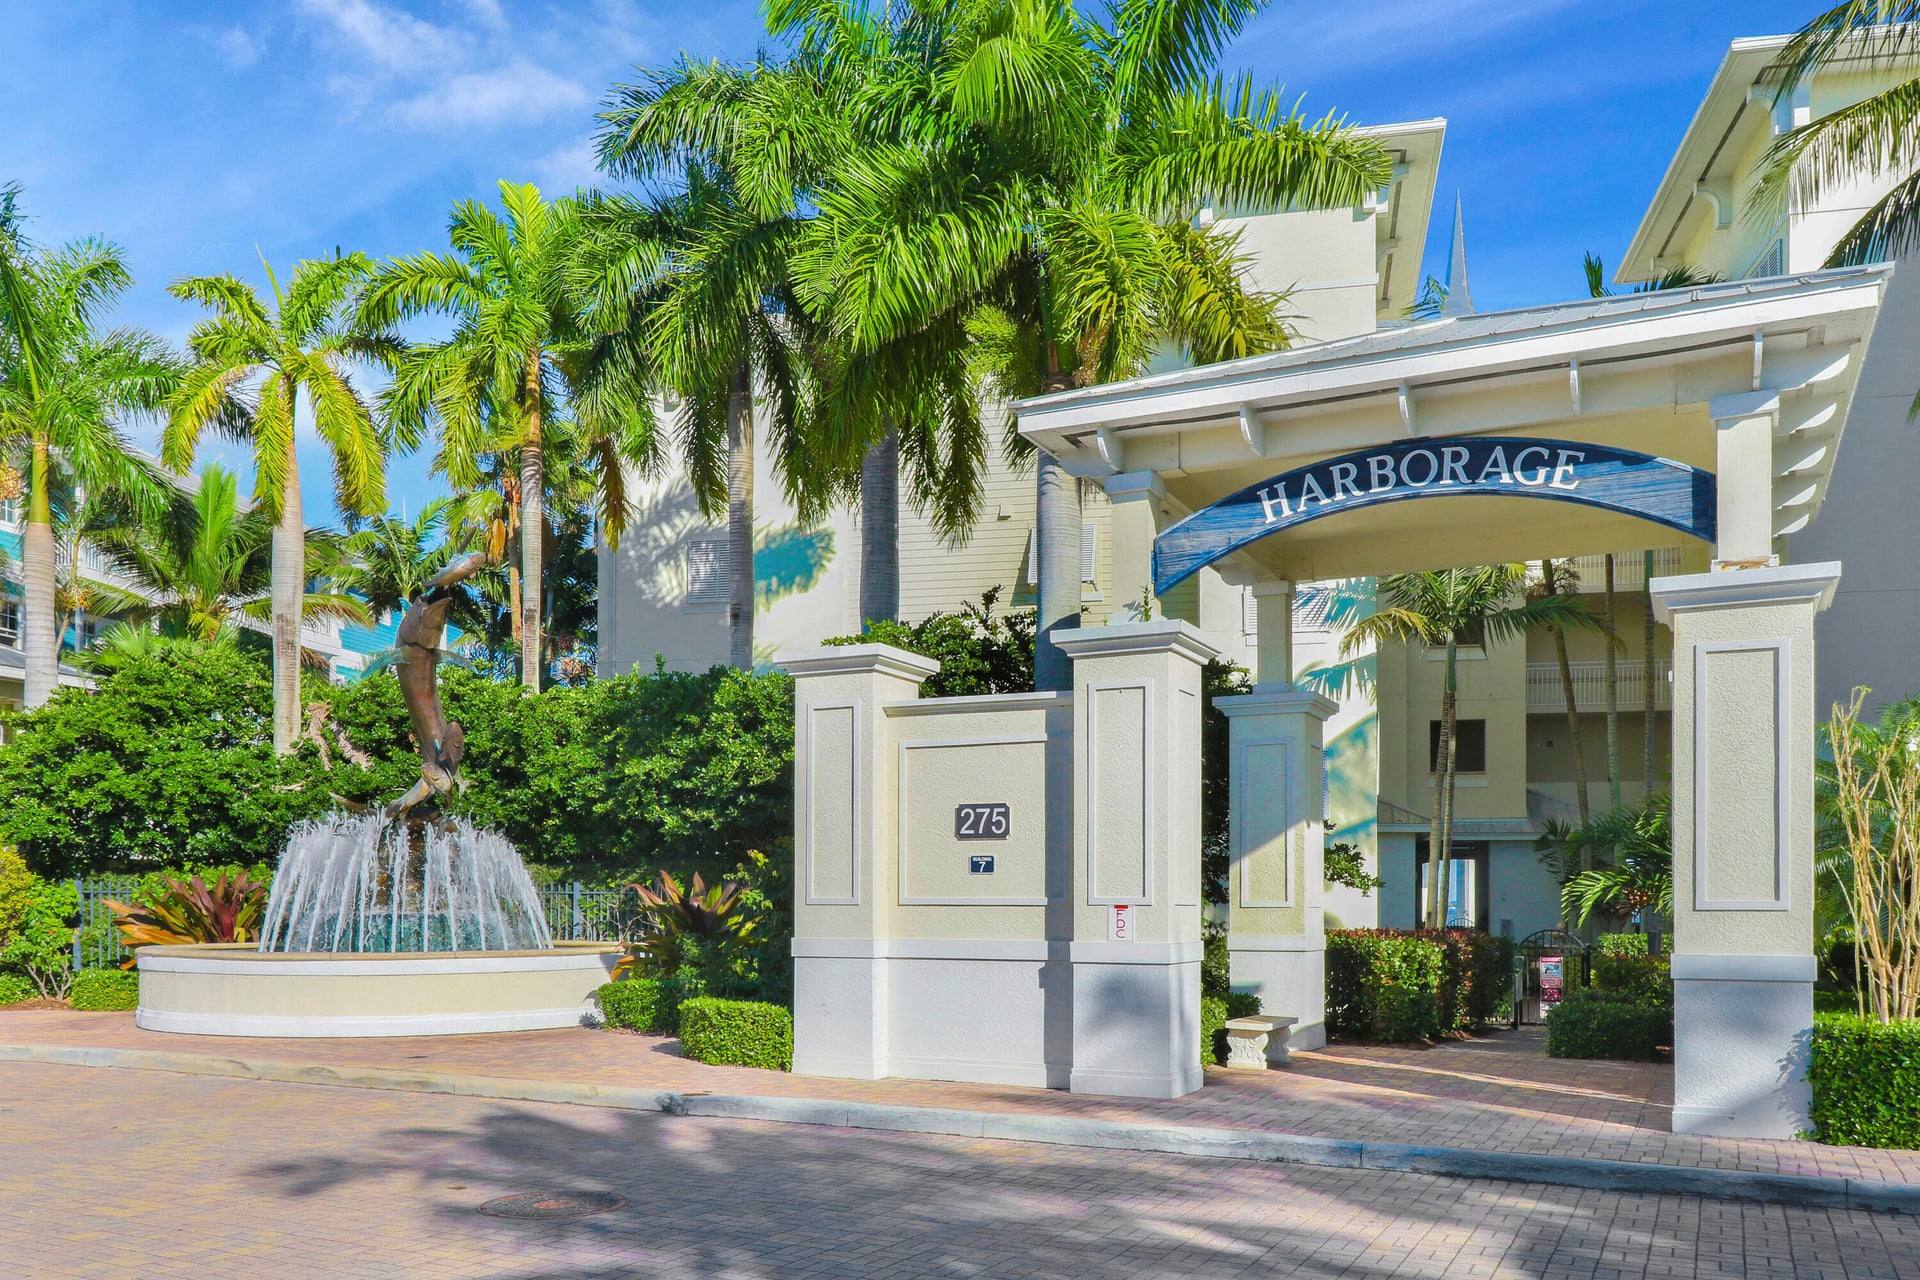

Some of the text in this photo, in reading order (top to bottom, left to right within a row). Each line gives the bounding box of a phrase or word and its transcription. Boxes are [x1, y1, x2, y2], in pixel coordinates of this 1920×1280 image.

[1256, 446, 1586, 524] HARBORAGE
[960, 808, 1006, 834] 275
[979, 861, 986, 873] 7
[1116, 909, 1126, 939] FDC
